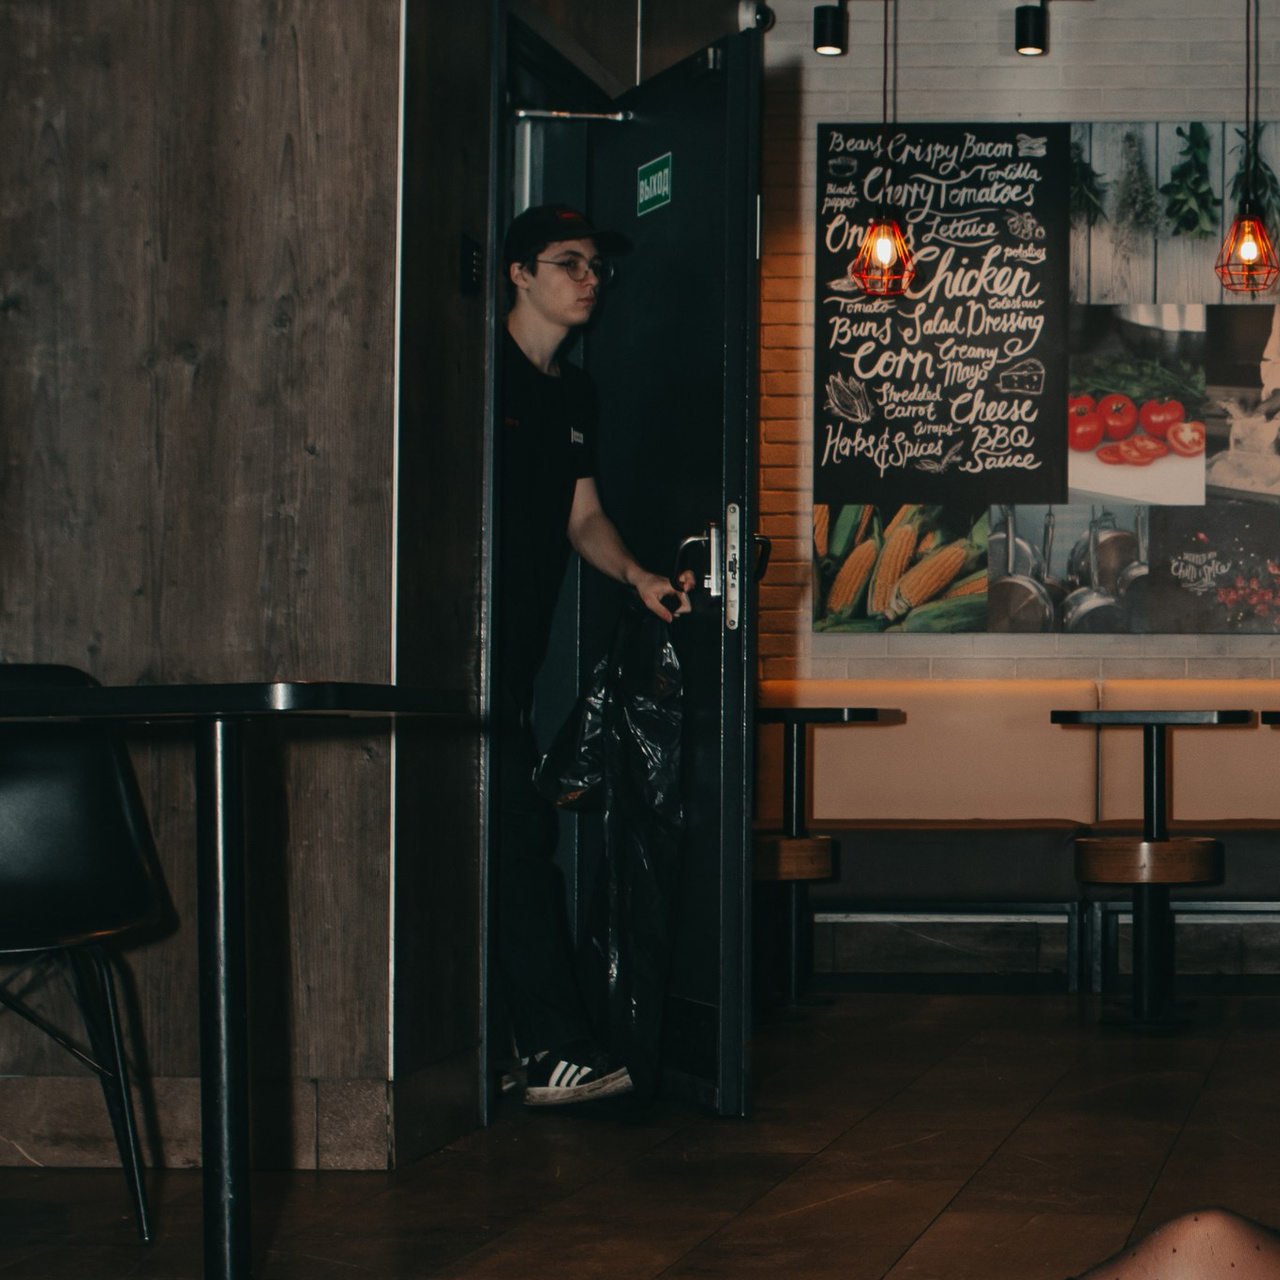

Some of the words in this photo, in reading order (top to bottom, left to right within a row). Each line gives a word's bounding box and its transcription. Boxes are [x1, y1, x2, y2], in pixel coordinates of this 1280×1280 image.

[828, 131, 884, 159] Beans
[887, 133, 960, 175] Crispy
[960, 132, 1013, 164] Bacon
[639, 168, 669, 203] ВЫХОД
[962, 163, 1043, 181] Tortilla
[825, 182, 858, 195] Black
[863, 166, 936, 224] Cherry
[909, 173, 1035, 209] Tomatoes
[821, 196, 860, 215] pepper
[825, 213, 917, 257] Onis
[921, 216, 1001, 243] Lettuce
[898, 244, 1041, 303] Chicken
[823, 296, 898, 314] Tomato
[828, 316, 893, 349] Buns
[897, 302, 965, 345] Salad
[966, 300, 1045, 354] Dressing
[839, 341, 935, 381] Corn
[934, 338, 1000, 369] Creamy
[936, 362, 990, 390] Mayo
[872, 382, 943, 406] Shredded
[948, 389, 1039, 425] Cheese
[883, 402, 937, 421] Carrot
[821, 422, 876, 467] Herbs
[888, 431, 944, 469] Spices
[971, 424, 1035, 451] BBQ
[958, 447, 1042, 473] Sauce
